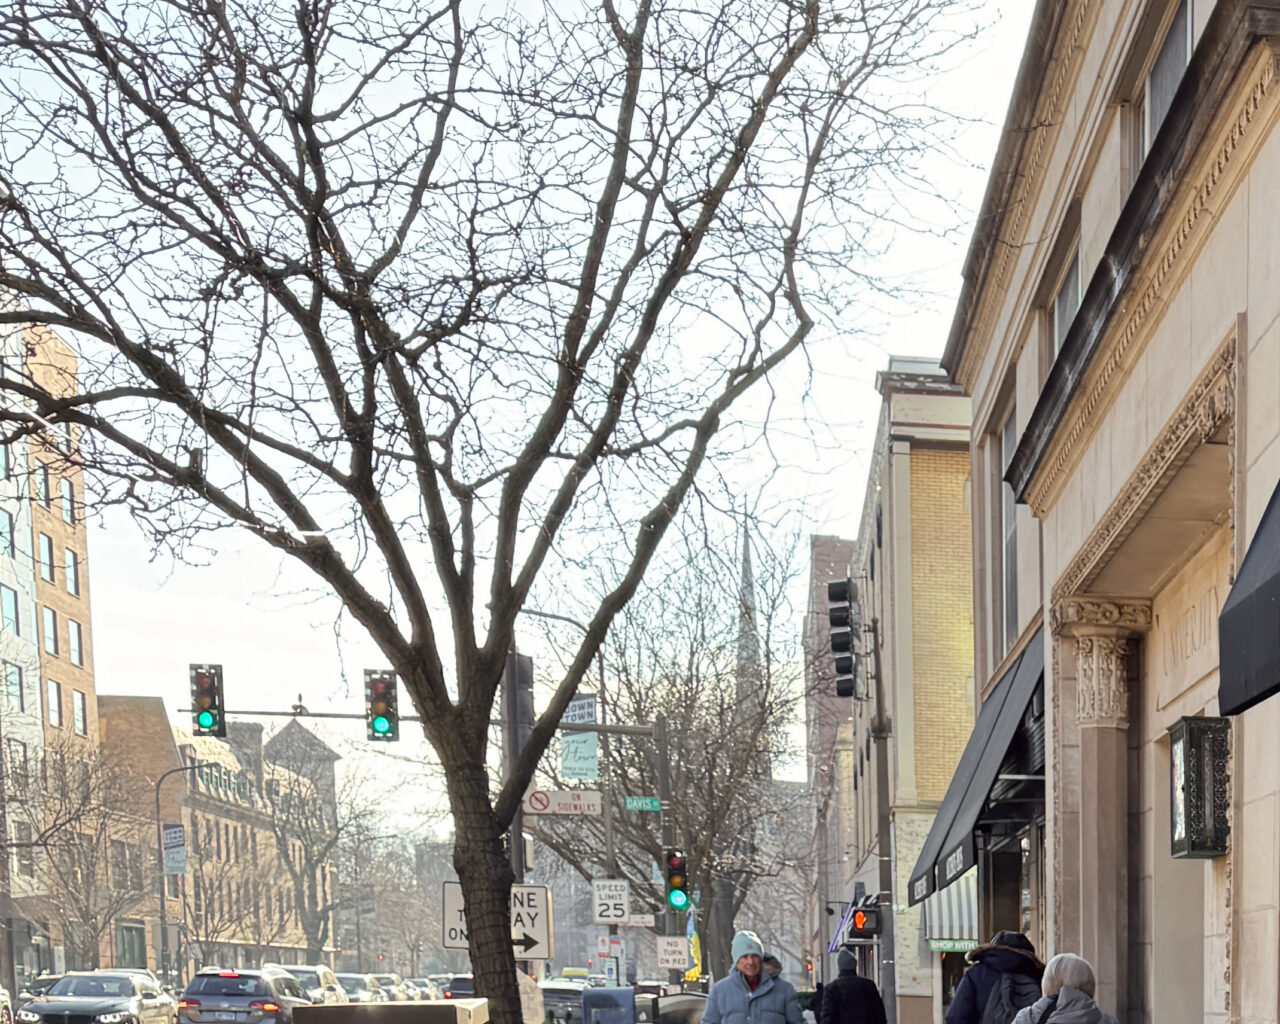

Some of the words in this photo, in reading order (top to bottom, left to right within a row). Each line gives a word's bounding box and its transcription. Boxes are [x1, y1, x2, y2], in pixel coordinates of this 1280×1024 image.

[566, 701, 593, 713] OWN
[564, 711, 593, 722] TOWN
[626, 798, 652, 809] DAVIS
[596, 884, 626, 892] SPEED
[513, 892, 537, 908] NE
[599, 893, 623, 901] LIMIT
[598, 903, 625, 918] 25
[513, 912, 539, 928] AY
[931, 940, 954, 950] SHOP
